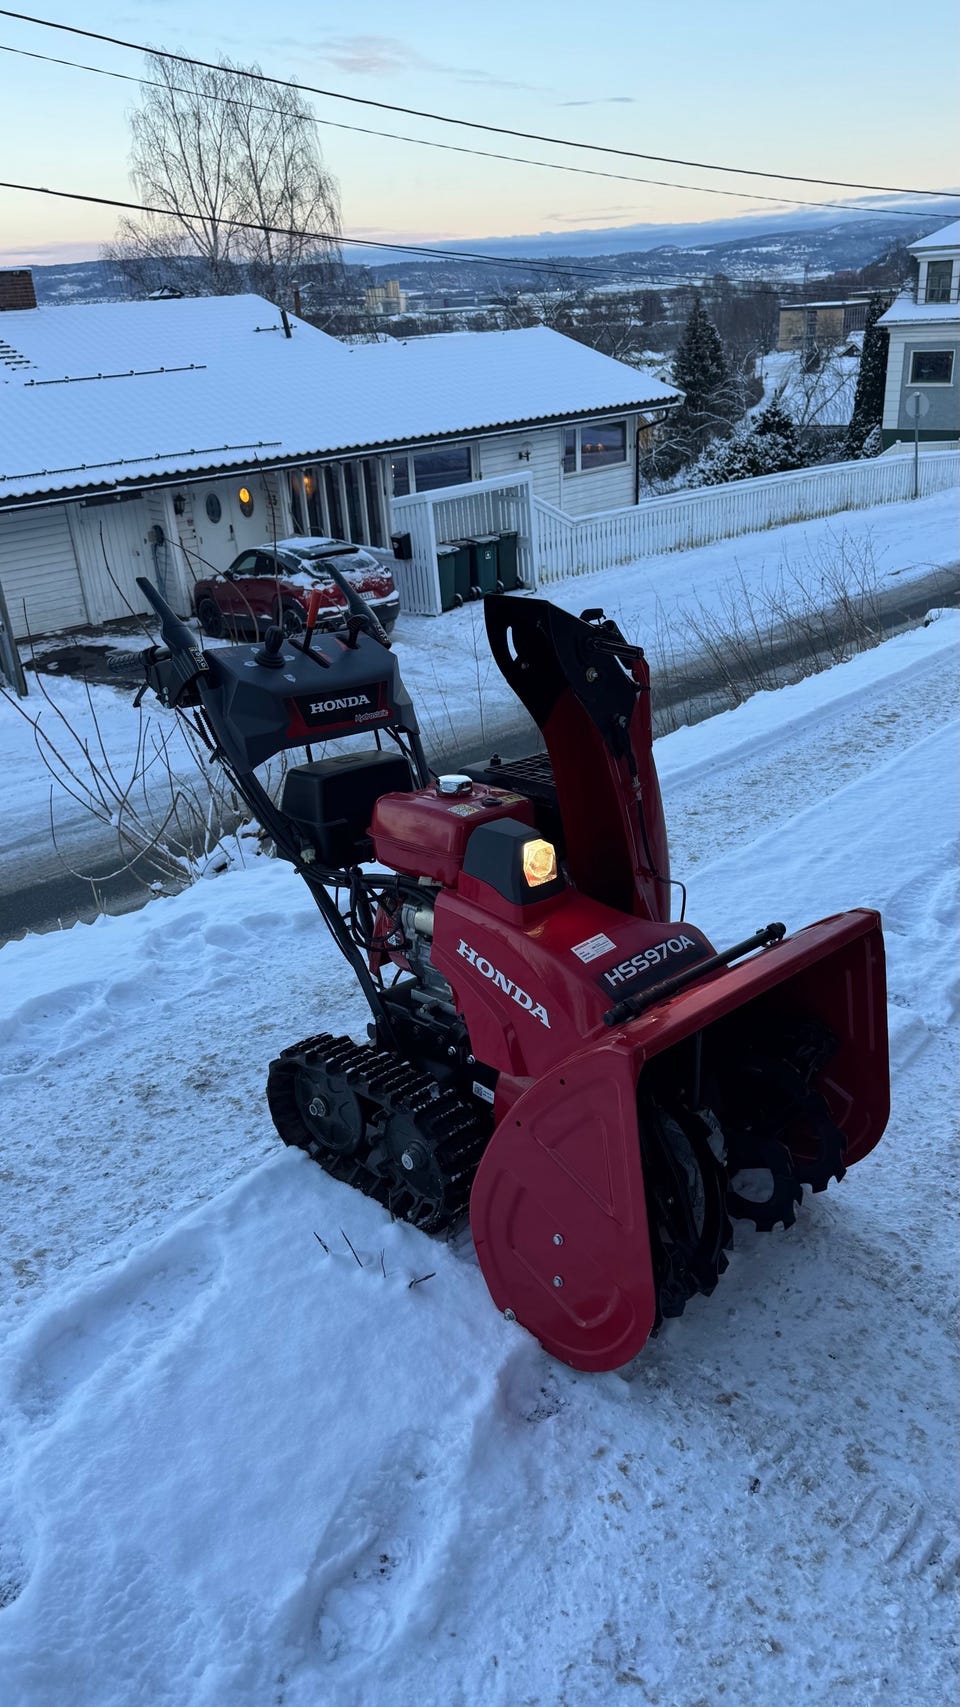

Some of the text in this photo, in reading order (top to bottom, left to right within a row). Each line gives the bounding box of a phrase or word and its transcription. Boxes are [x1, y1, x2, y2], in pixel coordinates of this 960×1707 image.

[309, 694, 371, 714] HONDA
[456, 938, 552, 1029] HONDA
[603, 934, 696, 987] HSS970A
